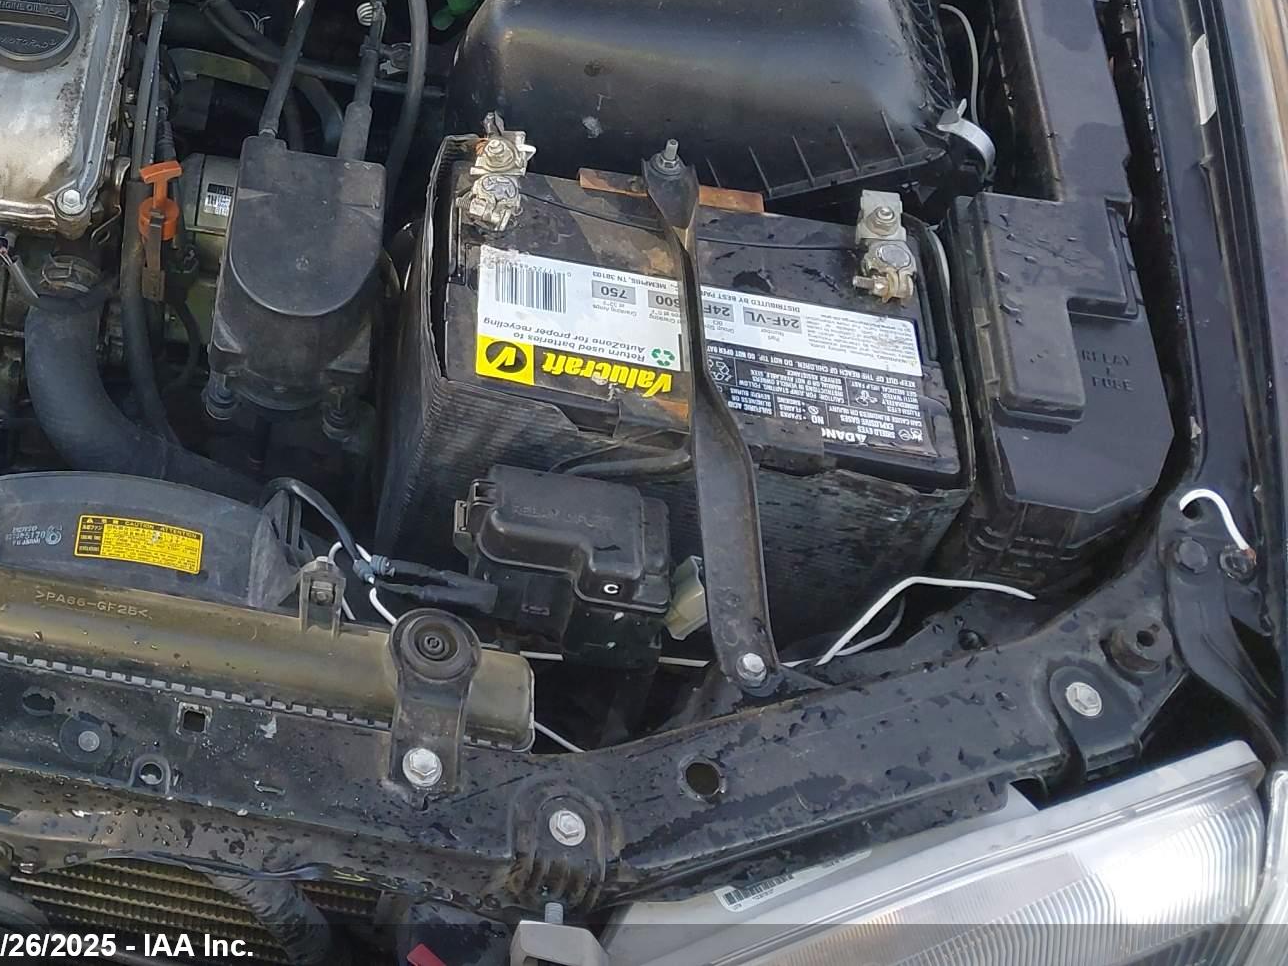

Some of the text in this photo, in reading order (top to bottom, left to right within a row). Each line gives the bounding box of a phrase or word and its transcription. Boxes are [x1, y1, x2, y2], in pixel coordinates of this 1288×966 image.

[26, 4, 42, 13] OIL
[592, 271, 616, 280] 38103
[628, 277, 666, 289] MEMPHIS,
[600, 286, 628, 299] 750
[718, 293, 737, 302] BEST
[703, 304, 730, 317] 24F
[750, 299, 800, 313] DISTRIBUTED
[744, 311, 800, 329] 24F-VL
[483, 318, 646, 353] AutoZone for proper recycling
[761, 328, 784, 337] Number
[513, 332, 645, 362] Return used batteries to
[718, 346, 734, 356] OPEN
[734, 350, 747, 358] NOT
[746, 352, 756, 360] DO
[770, 356, 783, 364] NOT
[542, 352, 671, 397] Valucraft
[839, 369, 860, 378] REACH
[860, 372, 874, 380] THE
[738, 379, 761, 389] FOLLOW
[775, 380, 798, 389] VEHICLE
[884, 377, 899, 385] OUT
[899, 379, 916, 387] KEEP
[805, 385, 844, 397] INSTRUCTIONS
[820, 382, 843, 391] MANUAL
[880, 386, 905, 395] MEDICAL
[729, 388, 771, 400] SEVERE BURNS
[805, 391, 817, 399] FOR
[740, 396, 772, 407] BLINDNESS
[882, 399, 919, 410] IMMEDIATELY
[727, 401, 772, 414] SULFURIC ACID
[829, 405, 850, 414] INJURY
[858, 410, 891, 421] BLINDNESS
[902, 409, 921, 417] FLUSH
[811, 415, 825, 424] NO
[839, 414, 894, 430] EXPLOSIVE GASES
[892, 416, 910, 425] CAUSE
[910, 419, 922, 427] CAN
[857, 425, 896, 439] SHIELD EYES
[124, 520, 155, 530] CAUTION
[159, 526, 197, 540] ATTENTION
[603, 584, 620, 594] C
